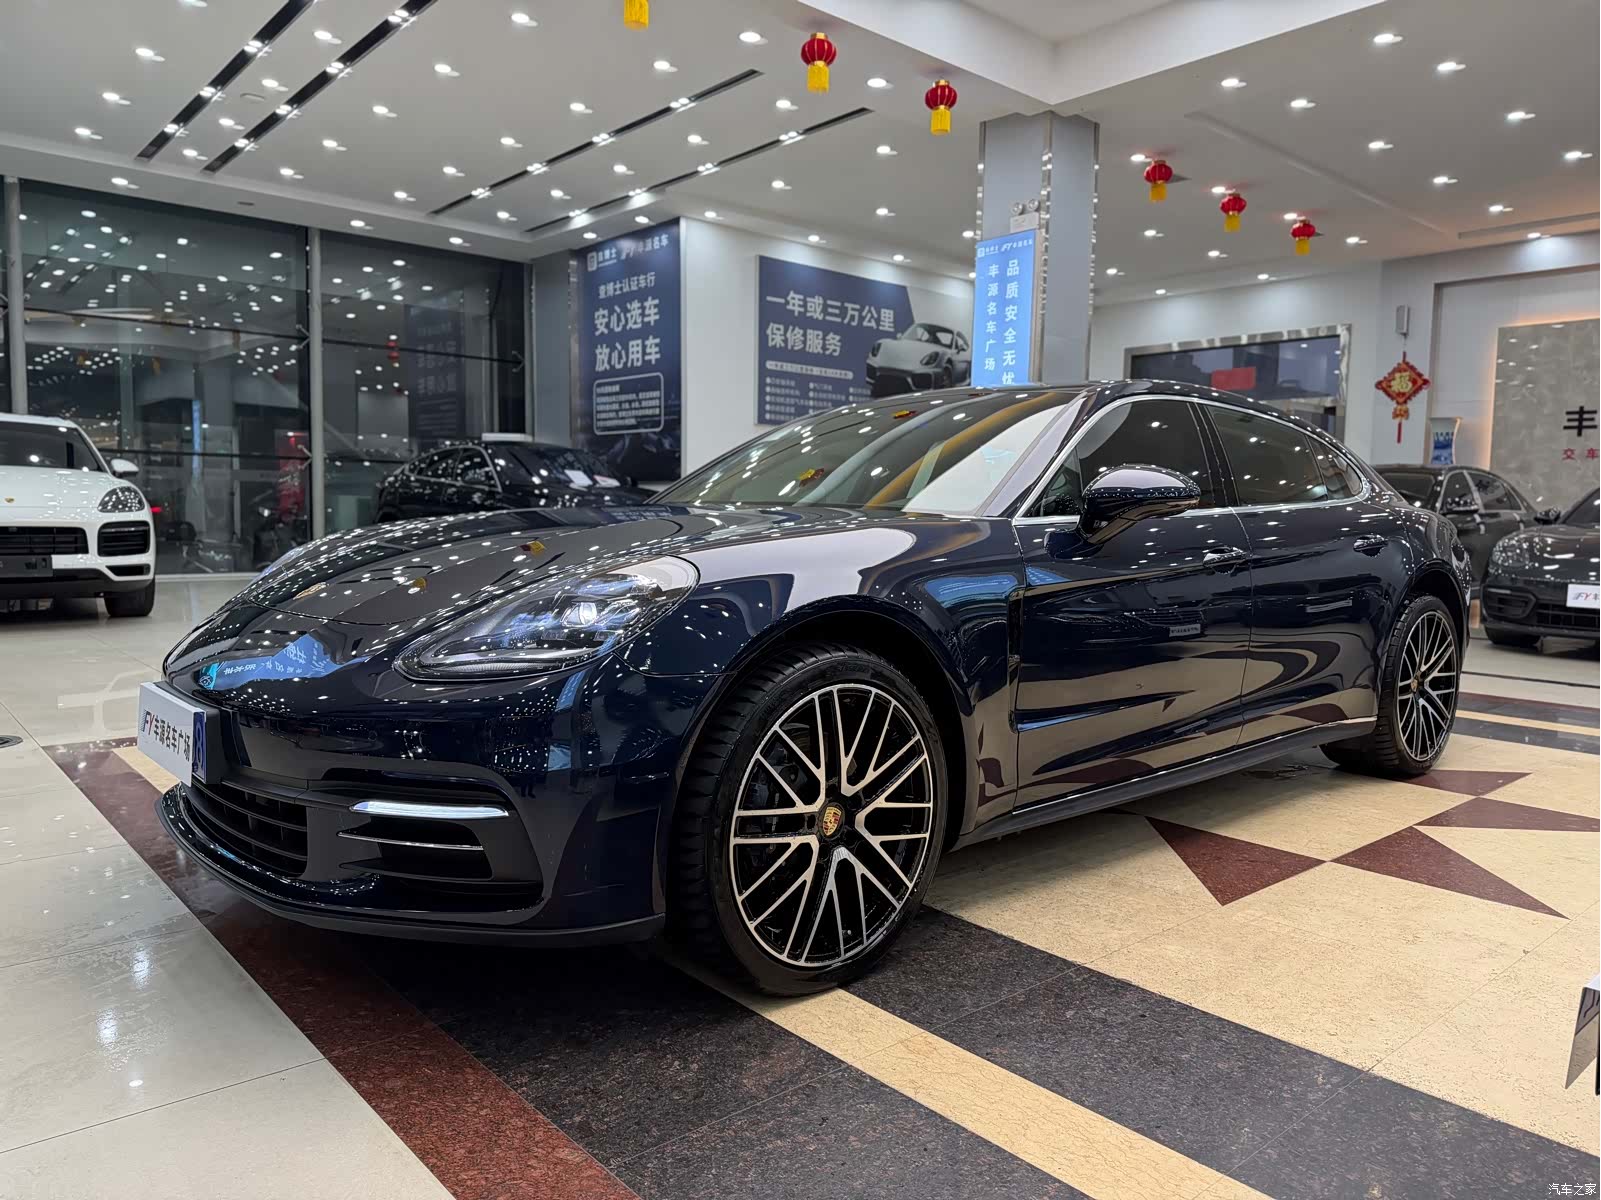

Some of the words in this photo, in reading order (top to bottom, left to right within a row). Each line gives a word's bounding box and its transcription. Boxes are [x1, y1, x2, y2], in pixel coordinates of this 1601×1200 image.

[594, 296, 660, 336] 安心选车
[766, 290, 896, 332] 一年或三万公里
[984, 263, 1000, 371] 丰源名车广场
[1002, 259, 1020, 385] 品质安全无忧
[595, 335, 661, 372] 放心用车
[766, 322, 842, 357] 保修服务
[1390, 371, 1413, 394] 福
[1563, 406, 1598, 437] 丰
[154, 715, 191, 762] 丰源名车广场
